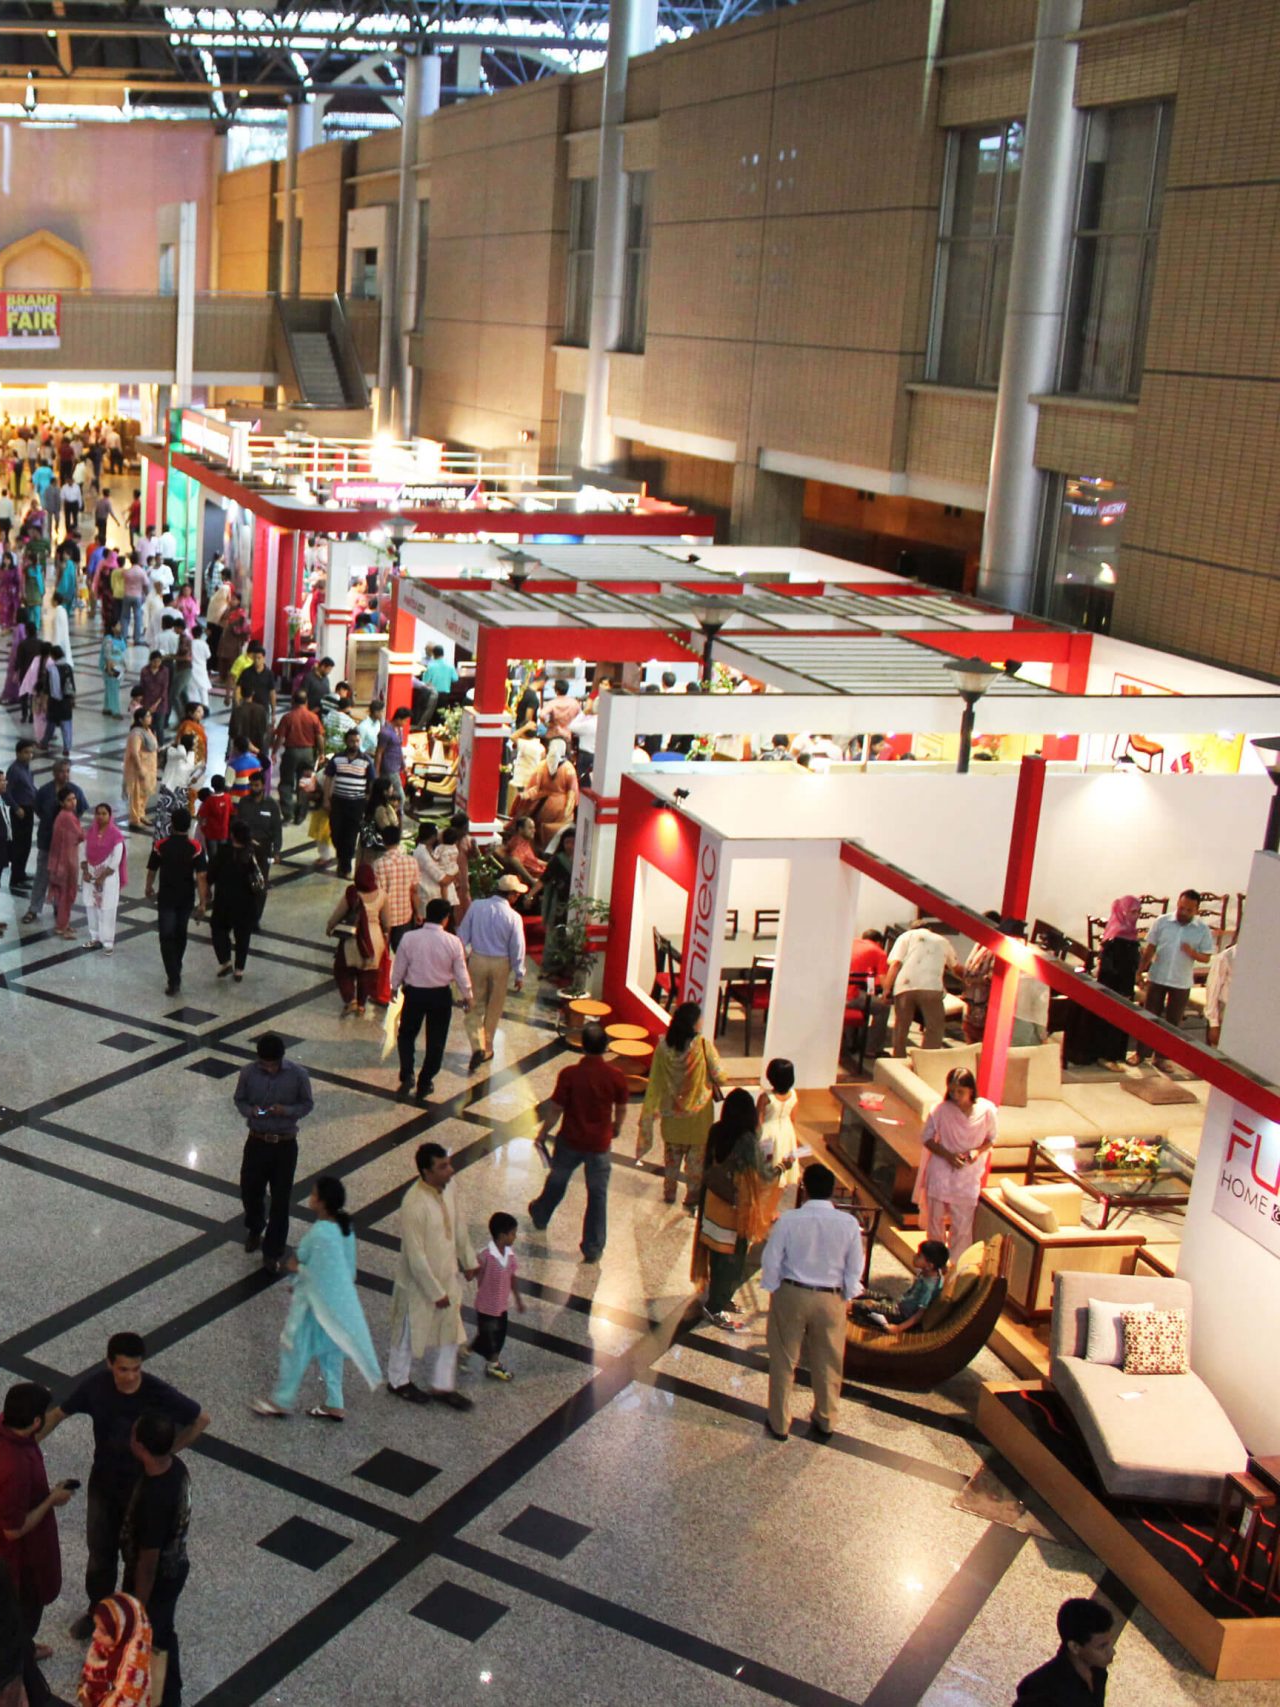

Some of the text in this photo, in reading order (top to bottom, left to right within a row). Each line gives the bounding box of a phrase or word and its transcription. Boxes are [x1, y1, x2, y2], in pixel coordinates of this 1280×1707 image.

[6, 294, 57, 305] BRAND
[7, 312, 57, 330] FAIR
[1221, 1170, 1269, 1215] HOME
